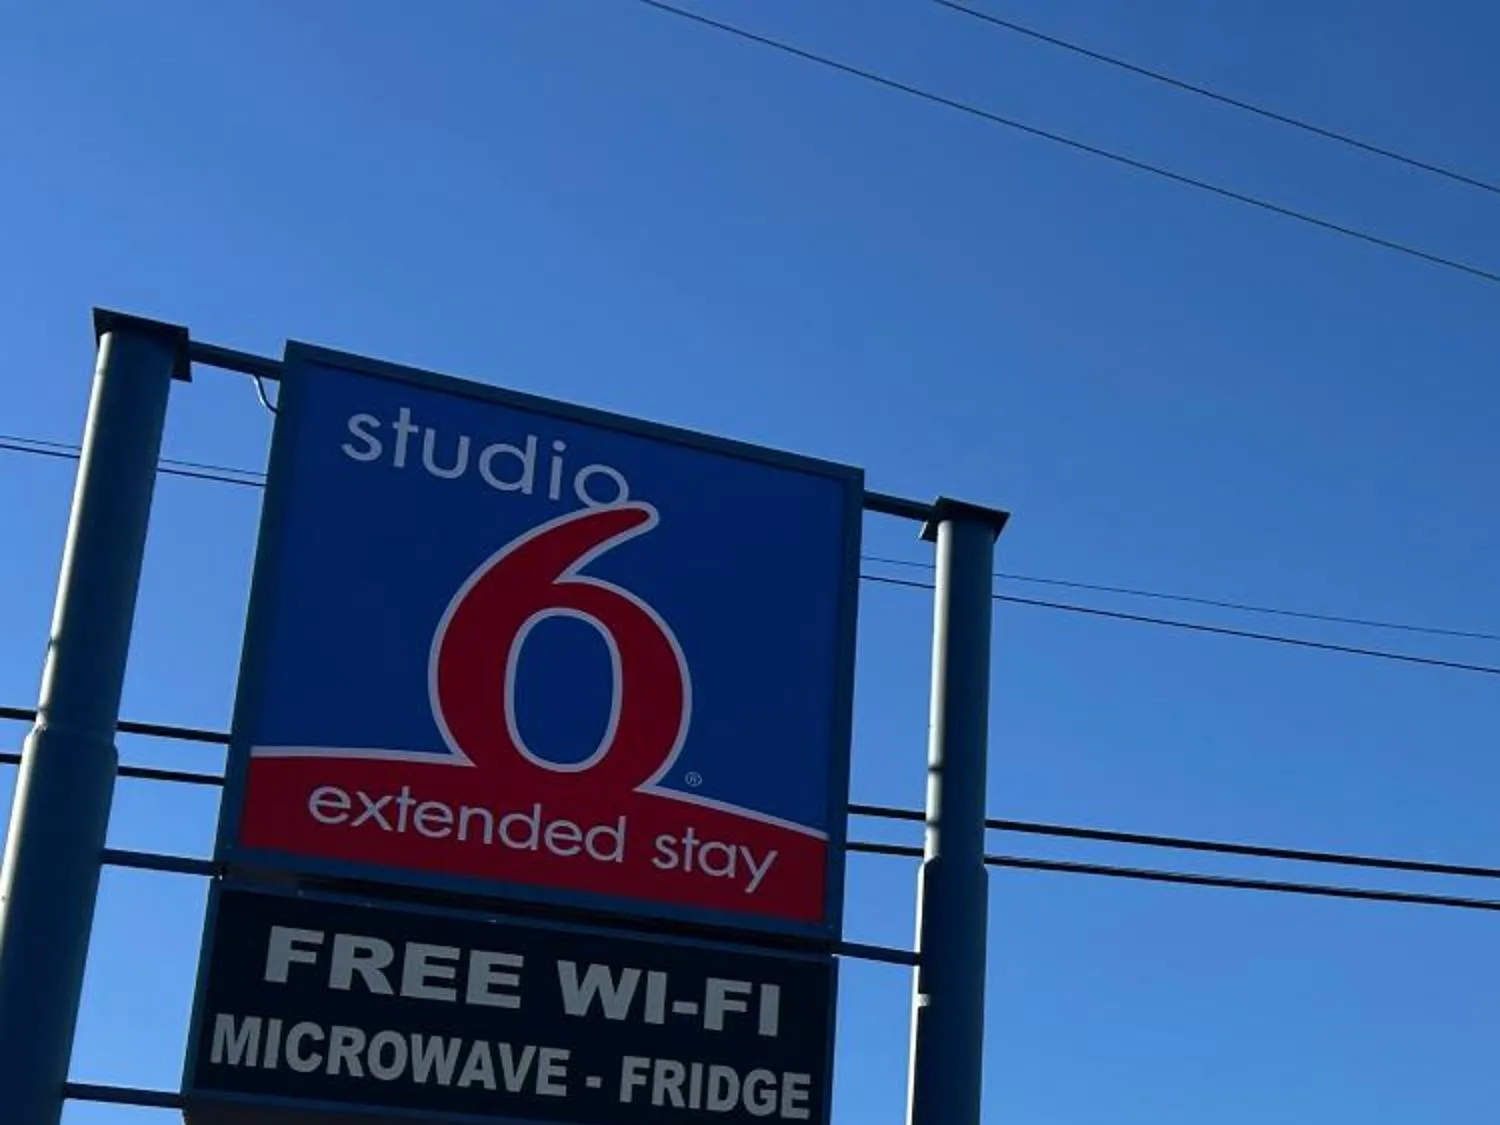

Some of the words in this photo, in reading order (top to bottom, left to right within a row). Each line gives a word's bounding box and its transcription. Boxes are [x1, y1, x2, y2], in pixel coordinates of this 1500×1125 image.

[340, 407, 630, 508] studio
[428, 500, 692, 792] 6
[308, 782, 628, 864] extended
[652, 826, 778, 893] stay
[263, 925, 525, 1010] FREE
[557, 959, 782, 1037] WI-FI
[210, 1013, 570, 1098] MICROWAVE
[620, 1055, 812, 1120] FRIDGE
